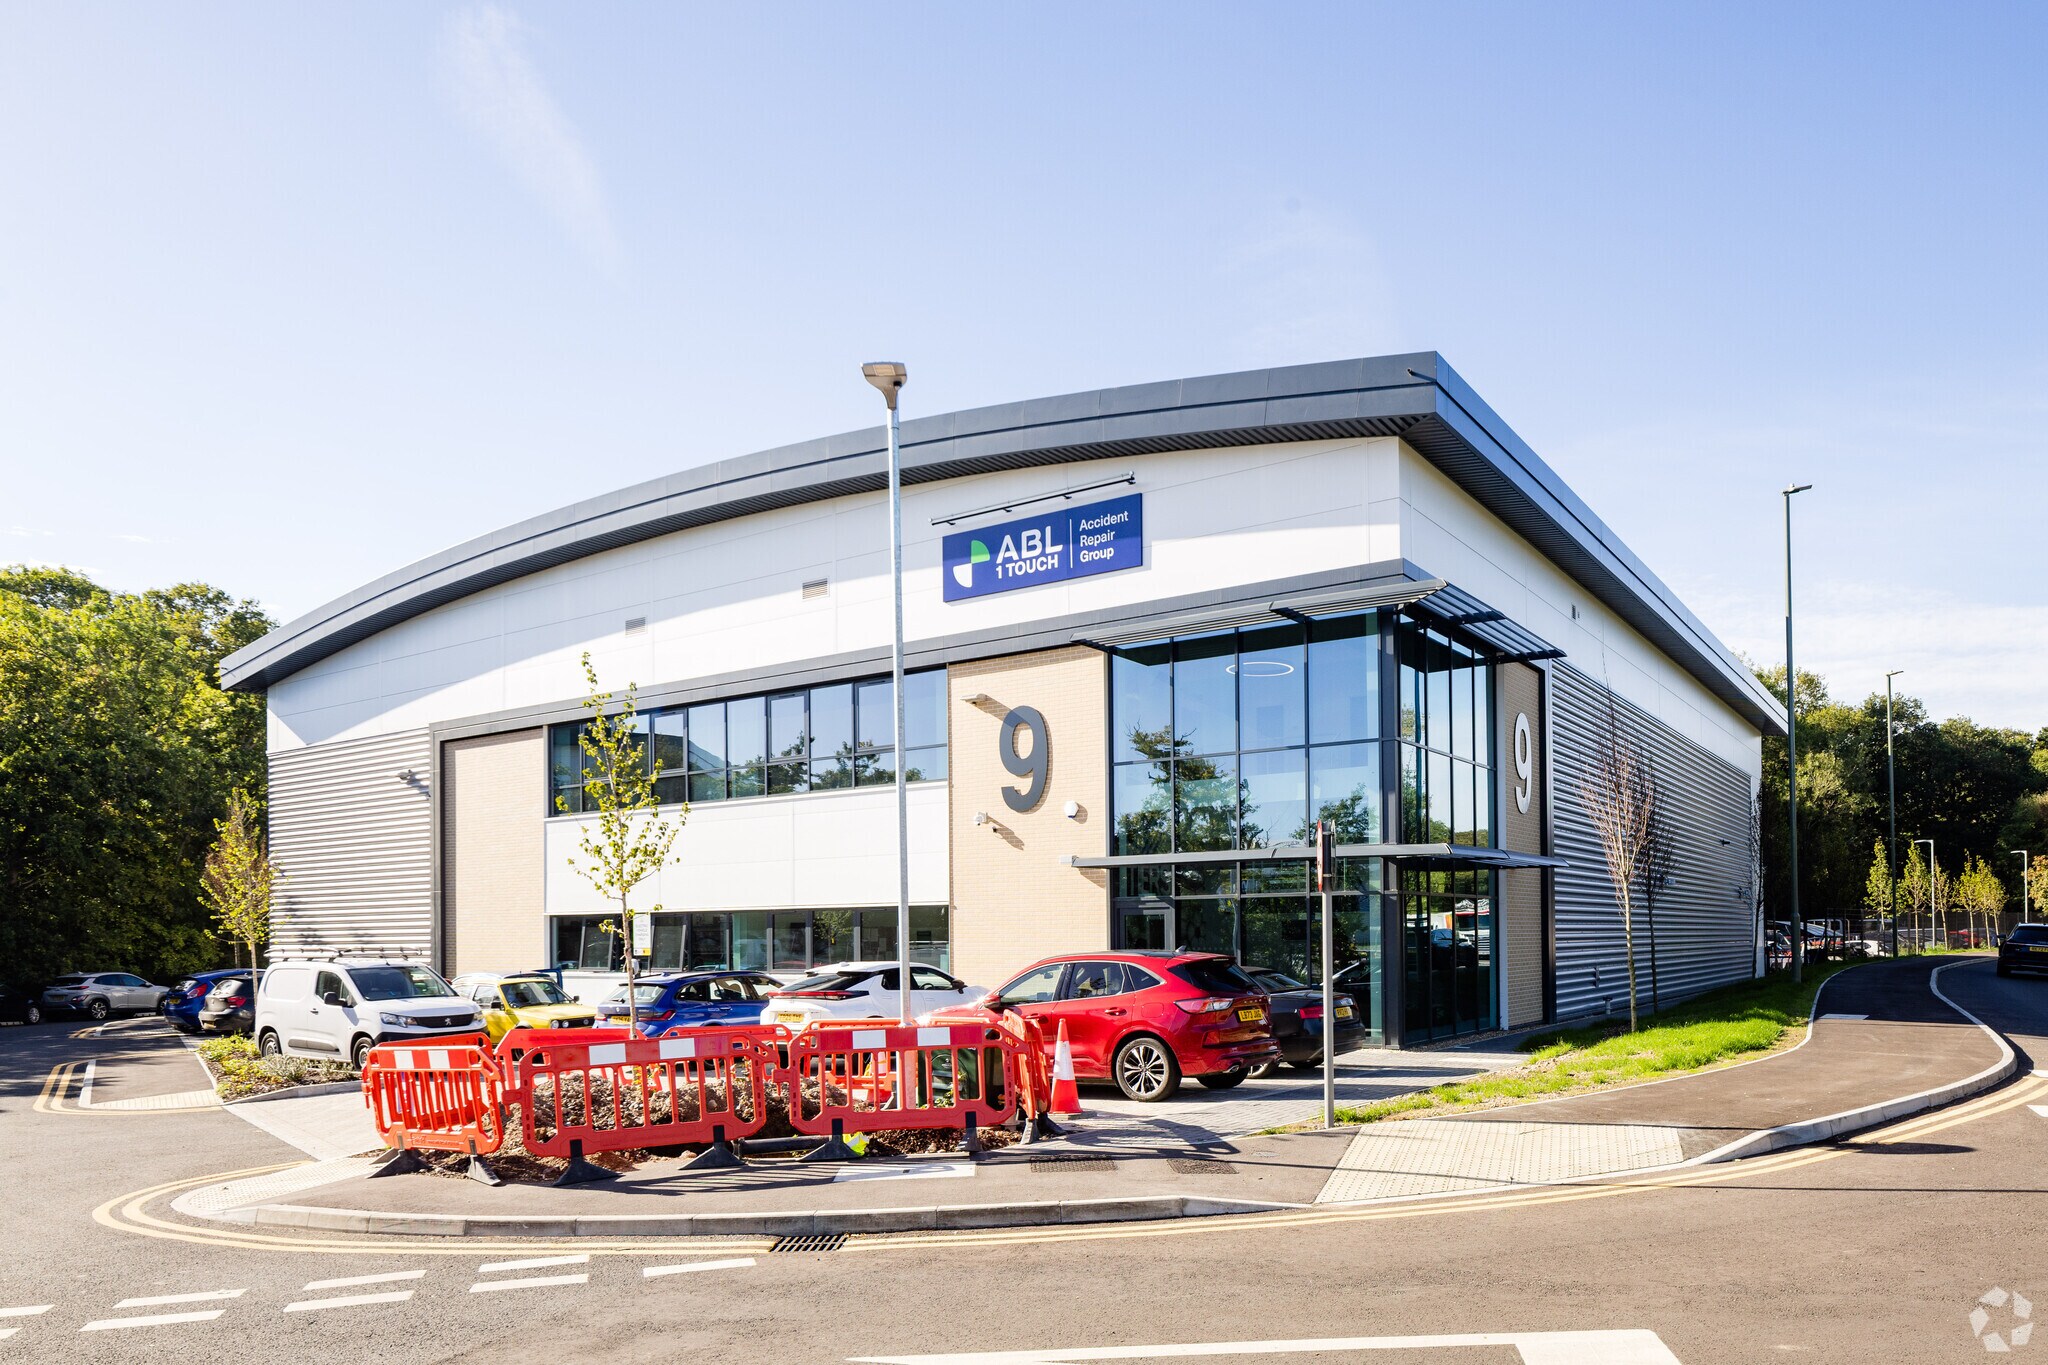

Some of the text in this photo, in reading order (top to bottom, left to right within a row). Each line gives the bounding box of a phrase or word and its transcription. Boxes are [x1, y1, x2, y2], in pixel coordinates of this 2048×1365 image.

[1079, 510, 1129, 532] Accident
[995, 525, 1064, 564] ABL
[1080, 529, 1116, 549] Repair
[995, 554, 1059, 579] 1 TOUCH
[1079, 547, 1115, 563] Group
[999, 705, 1049, 812] 9
[1514, 711, 1532, 815] 9
